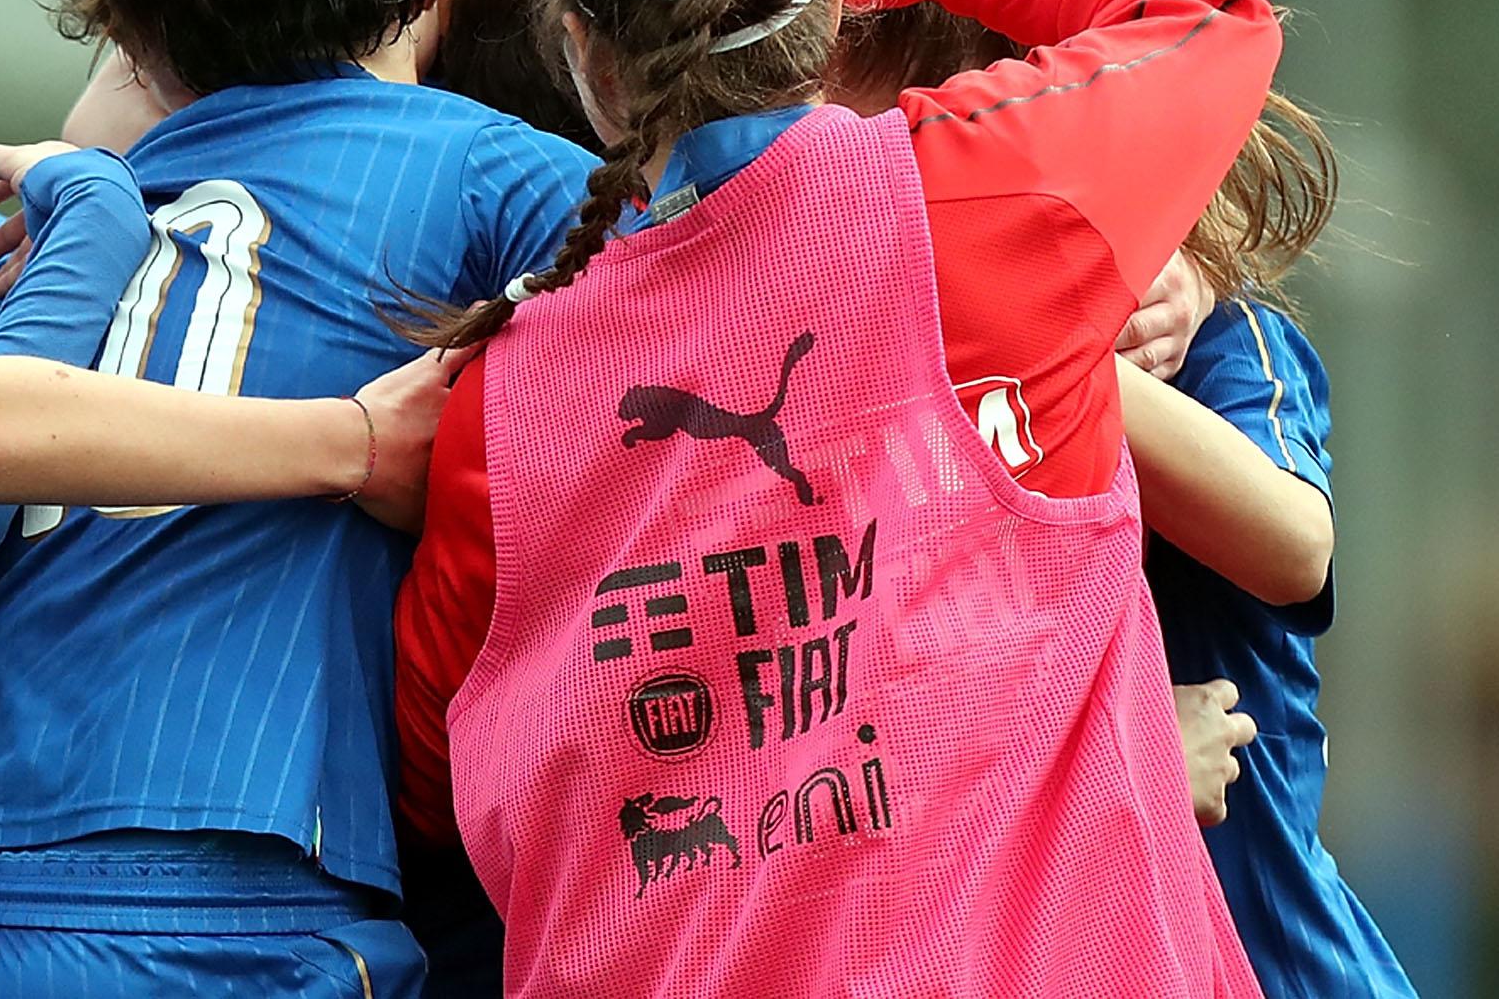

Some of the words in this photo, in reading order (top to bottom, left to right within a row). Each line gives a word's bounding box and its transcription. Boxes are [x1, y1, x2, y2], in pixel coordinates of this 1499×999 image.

[21, 179, 272, 540] 0
[702, 517, 877, 637] TIM
[644, 690, 698, 740] FIAT
[736, 619, 857, 751] FIAT
[756, 723, 892, 861] eni
